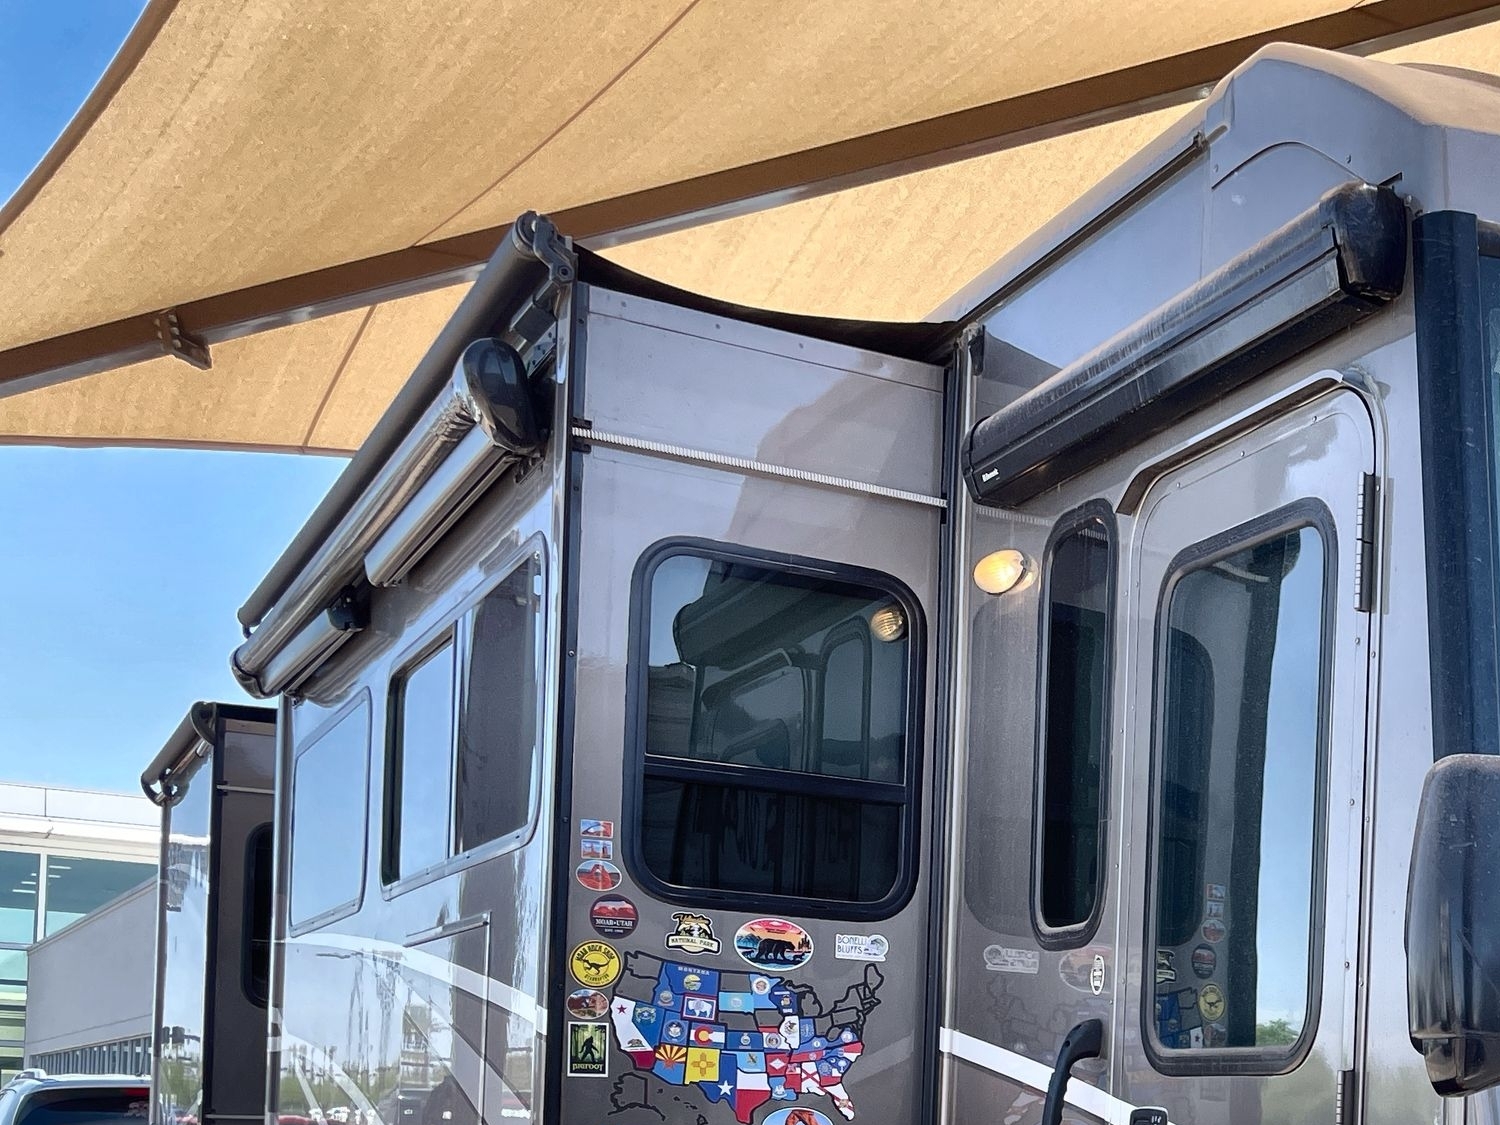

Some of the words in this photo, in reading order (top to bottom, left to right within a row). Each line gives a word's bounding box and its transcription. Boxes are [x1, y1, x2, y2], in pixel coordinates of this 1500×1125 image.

[595, 918, 614, 926] MOAB
[616, 919, 633, 927] UTAH
[699, 939, 714, 948] PARK
[677, 966, 710, 976] MONTANA
